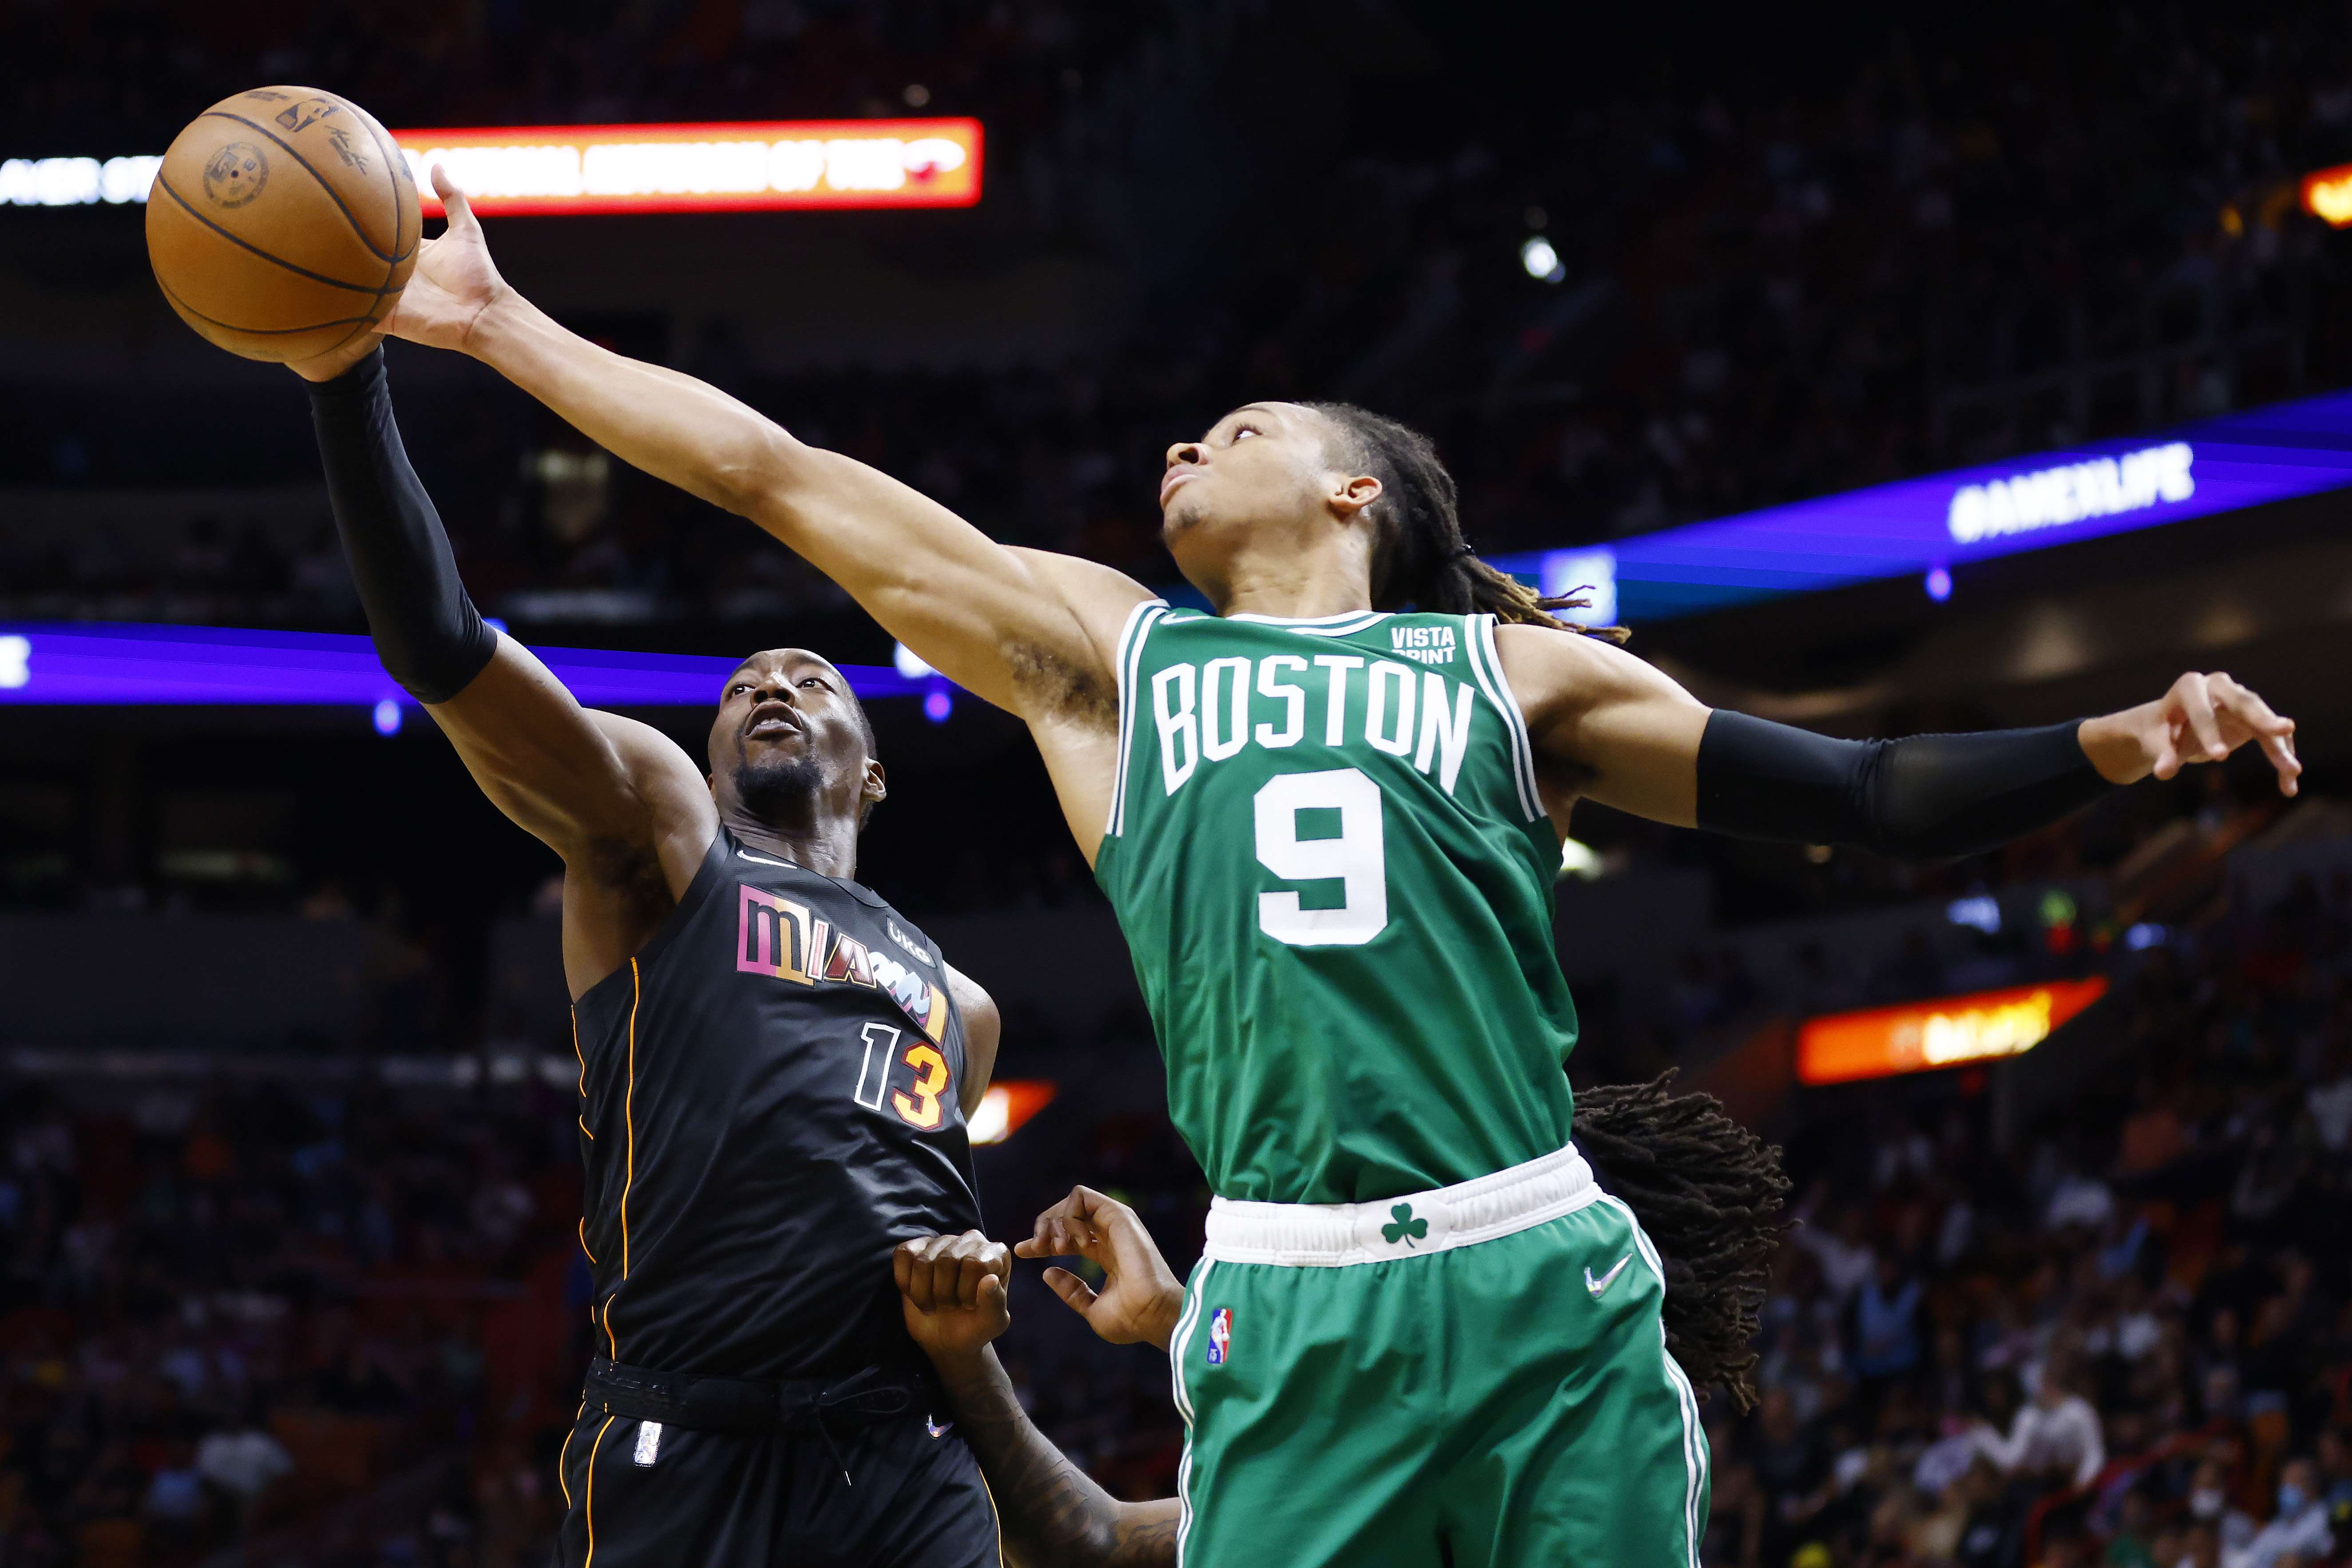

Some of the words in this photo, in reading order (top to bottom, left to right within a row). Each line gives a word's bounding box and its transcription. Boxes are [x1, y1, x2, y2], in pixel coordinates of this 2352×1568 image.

[1391, 626, 1456, 649] VISTA
[1152, 654, 1475, 796] BOSTON
[1253, 767, 1388, 946] 9
[854, 1022, 951, 1131] 13
